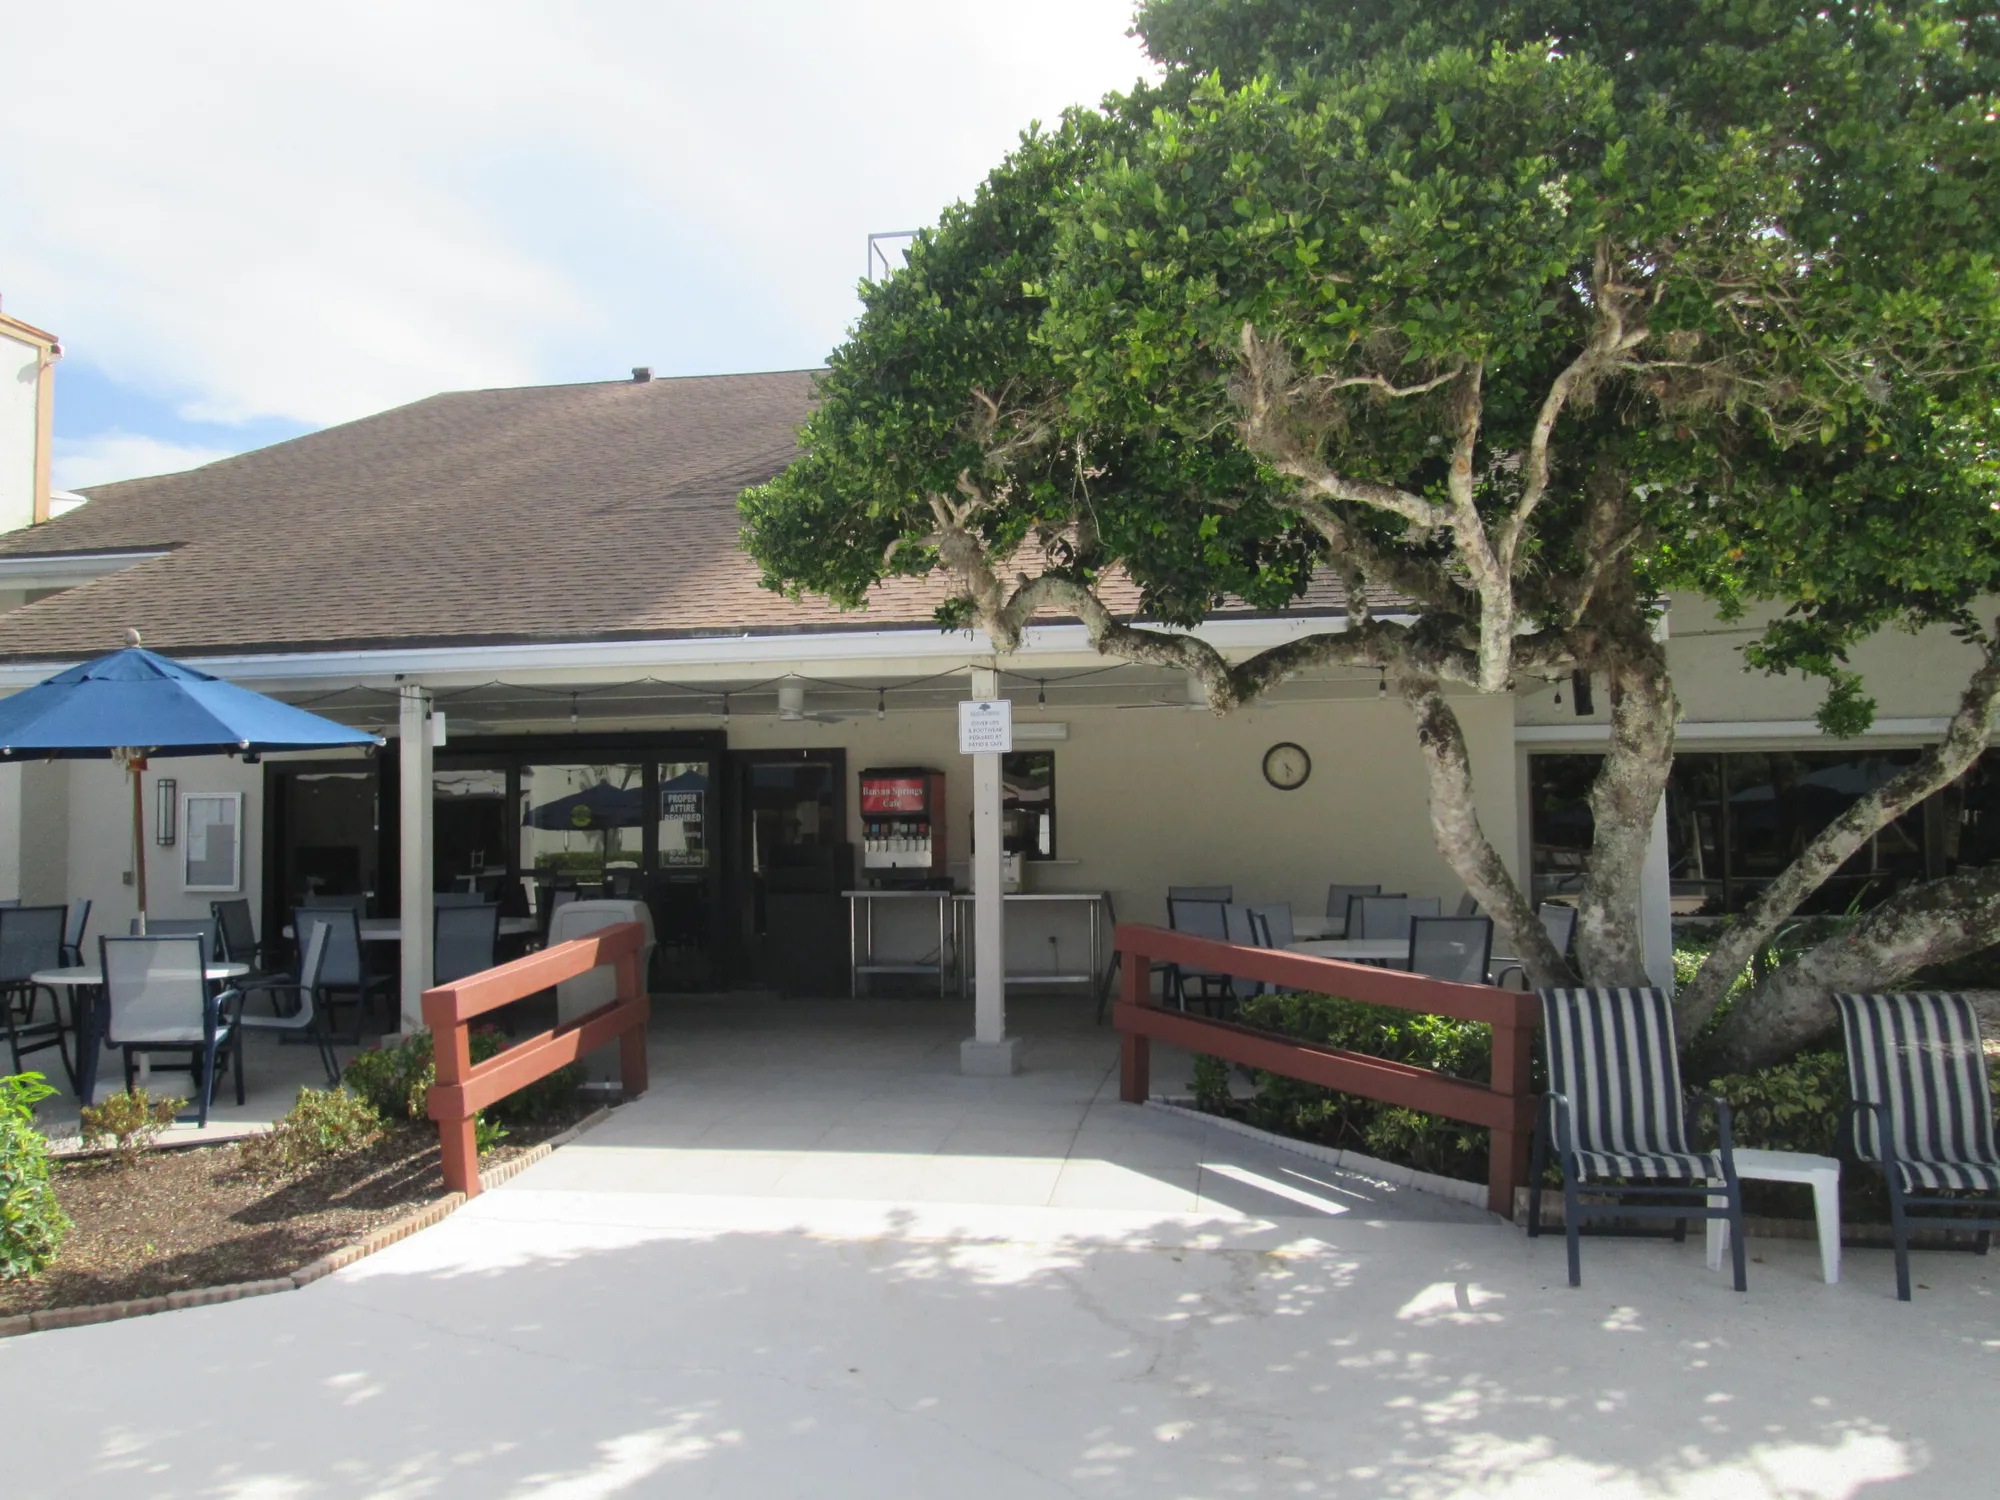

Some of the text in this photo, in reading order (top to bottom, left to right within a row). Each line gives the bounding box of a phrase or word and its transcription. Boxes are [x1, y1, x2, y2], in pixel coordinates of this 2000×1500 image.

[863, 786, 923, 797] Banyan Springs
[668, 794, 697, 803] PROPER
[669, 804, 696, 812] ATTIRE
